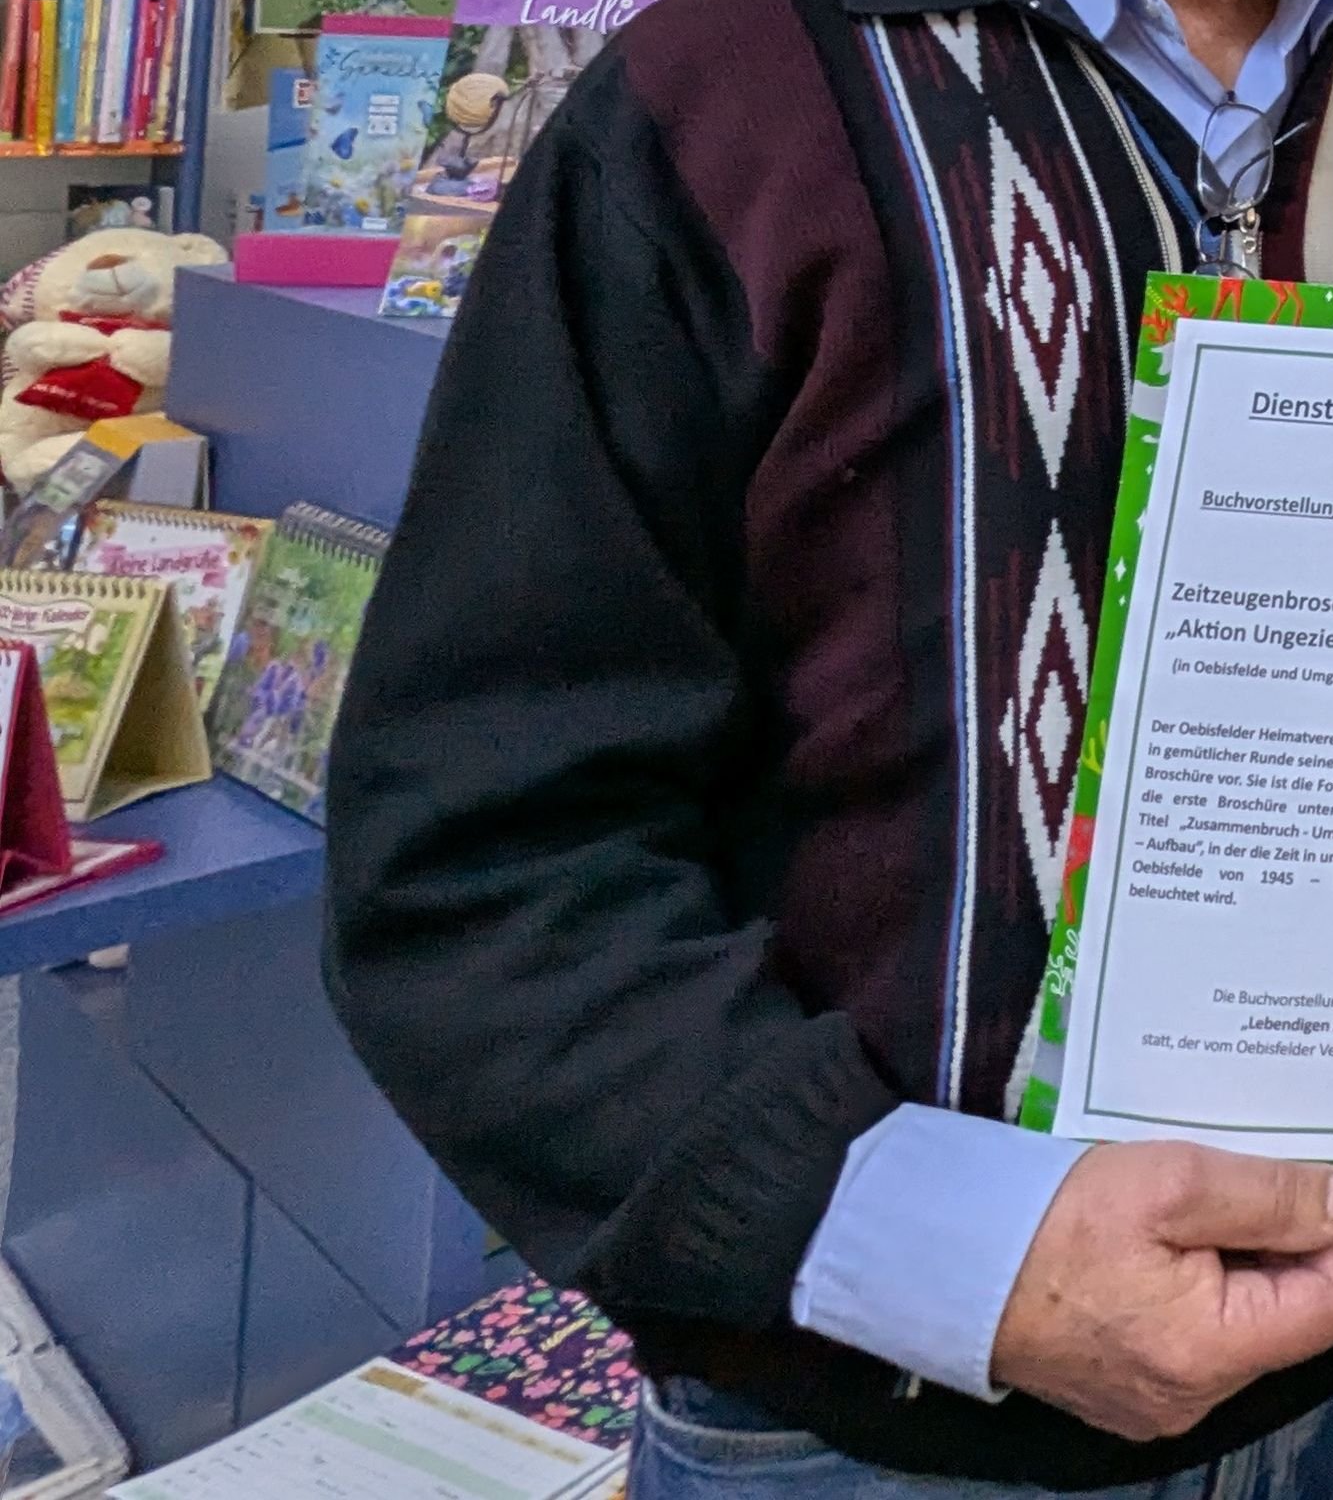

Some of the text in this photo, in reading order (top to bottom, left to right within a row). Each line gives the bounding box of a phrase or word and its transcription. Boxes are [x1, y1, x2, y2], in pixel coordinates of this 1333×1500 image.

[1164, 619, 1247, 643] „Aktion
[1172, 657, 1191, 675] (in
[1193, 660, 1268, 678] Oebisfelde
[1271, 666, 1299, 681] und
[1151, 719, 1177, 734] Der
[1178, 721, 1256, 740] Oebisfelder
[1147, 742, 1161, 756] in
[1162, 746, 1248, 763] gemütlicher
[1249, 750, 1295, 767] Runde
[1144, 765, 1214, 784] Broschüre
[1217, 774, 1243, 787] vor.
[1246, 773, 1268, 789] Sie
[1270, 775, 1288, 790] ist
[1290, 776, 1314, 792] die
[1141, 789, 1163, 804] die
[1172, 794, 1208, 807] erste
[1217, 795, 1288, 813] Broschüre
[1138, 812, 1169, 828] Titel
[1179, 815, 1300, 838] „Zusammenbruch
[1145, 837, 1205, 857] Aufbau“,
[1207, 841, 1221, 856] in
[1223, 843, 1248, 858] der
[1249, 845, 1271, 860] die
[1273, 846, 1300, 862] Zeit
[1302, 848, 1317, 863] in
[1131, 859, 1204, 879] Oebisfelde
[1219, 869, 1245, 882] von
[1260, 869, 1294, 886] 1945
[1128, 882, 1237, 906] beleuchtet wird.
[1212, 988, 1236, 1004] Die
[1240, 1016, 1331, 1035] „Lebendigen
[1141, 1033, 1175, 1050] statt,
[1177, 1035, 1202, 1050] der
[1203, 1040, 1234, 1053] vom
[1236, 1039, 1317, 1057] Oebisfelder
